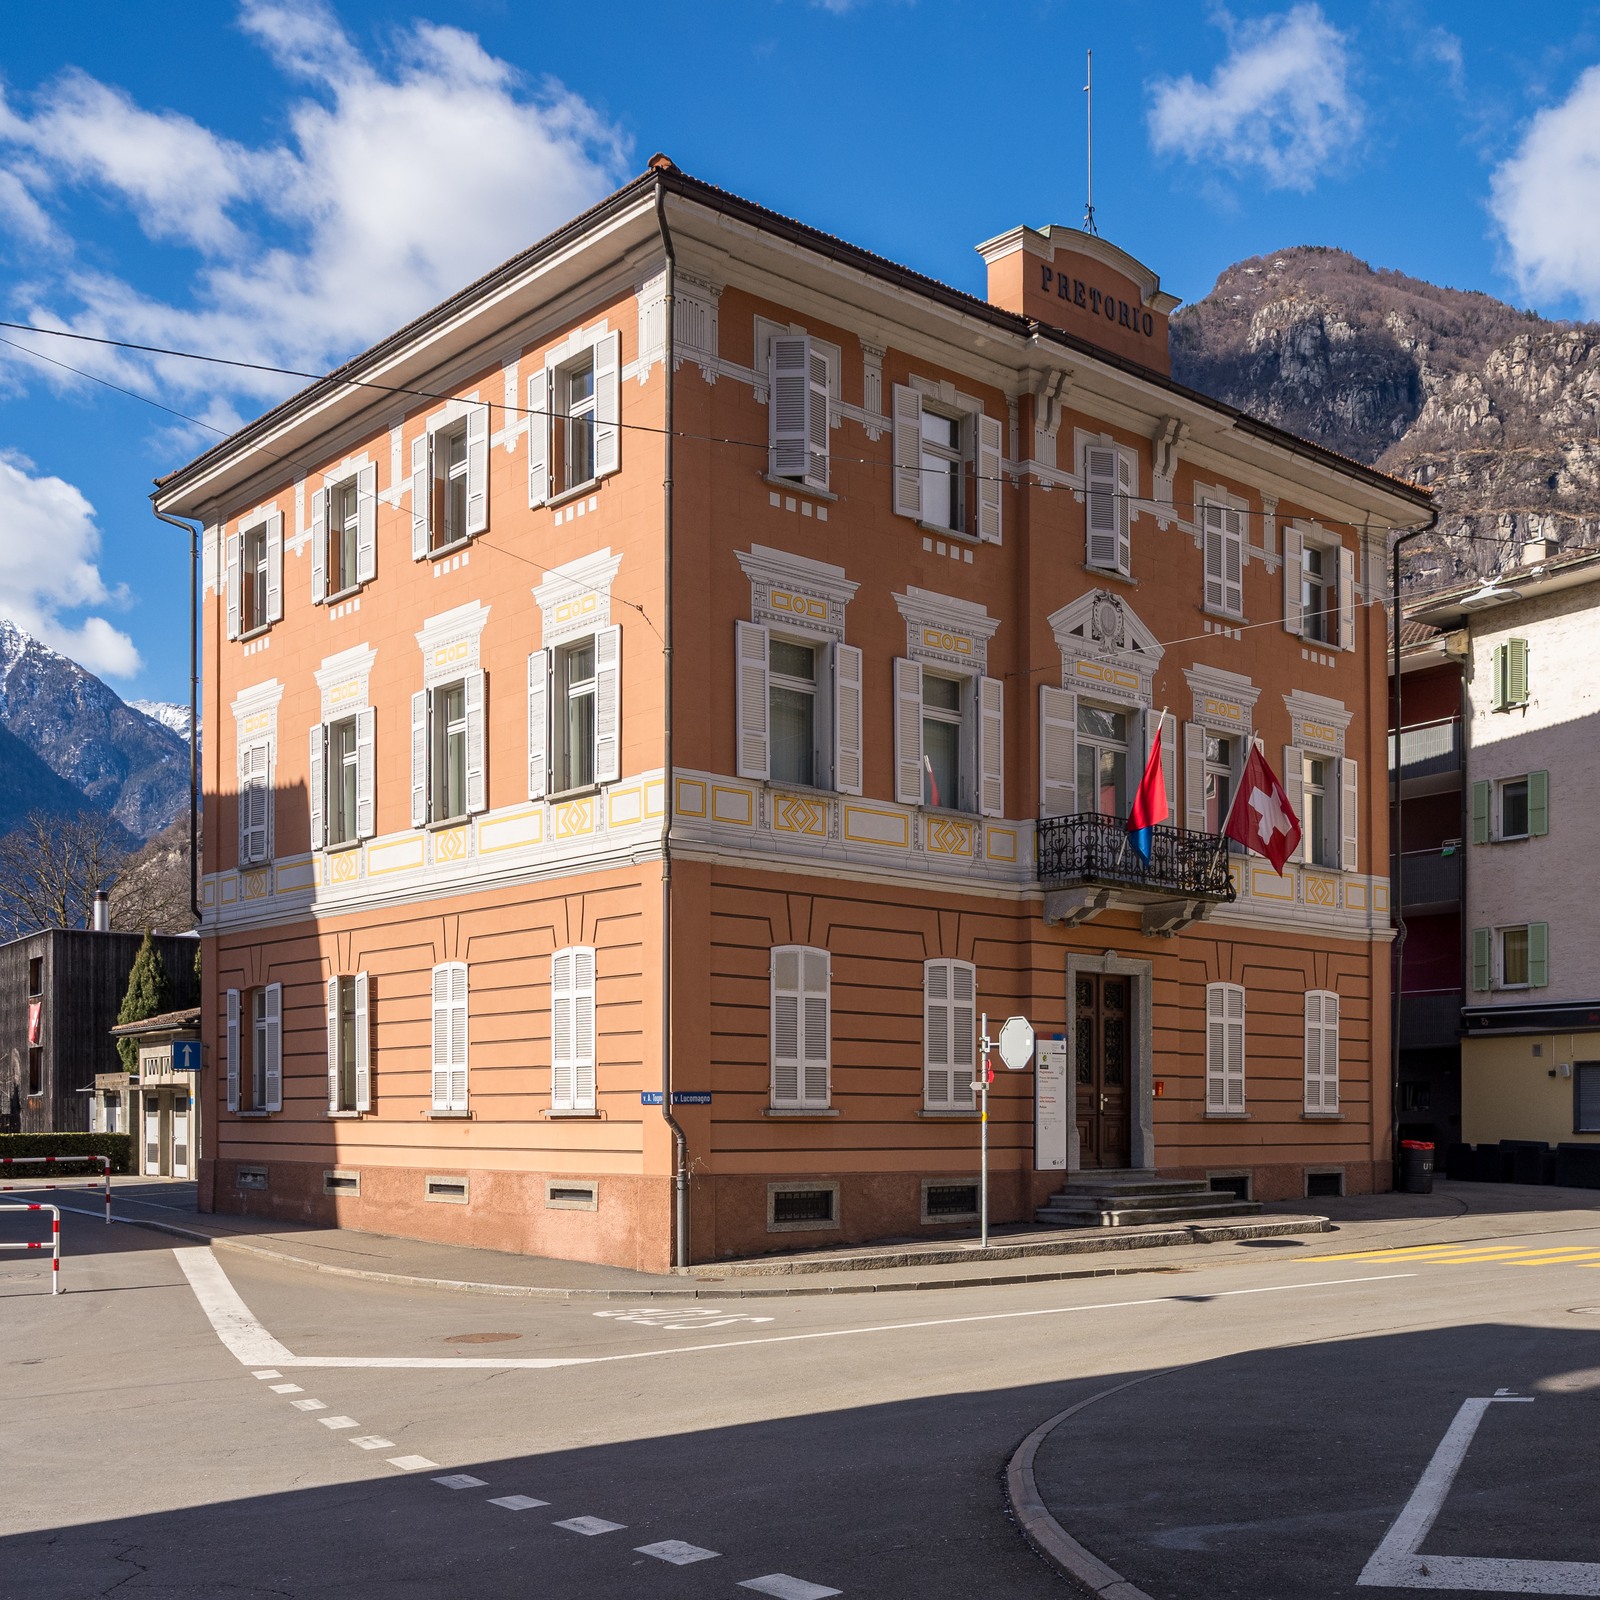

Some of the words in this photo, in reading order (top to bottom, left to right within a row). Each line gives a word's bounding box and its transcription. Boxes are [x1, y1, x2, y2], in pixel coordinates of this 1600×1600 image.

[1041, 264, 1153, 337] PRETORIO
[680, 1094, 710, 1104] Lucomagno
[592, 1307, 776, 1330] STOP
